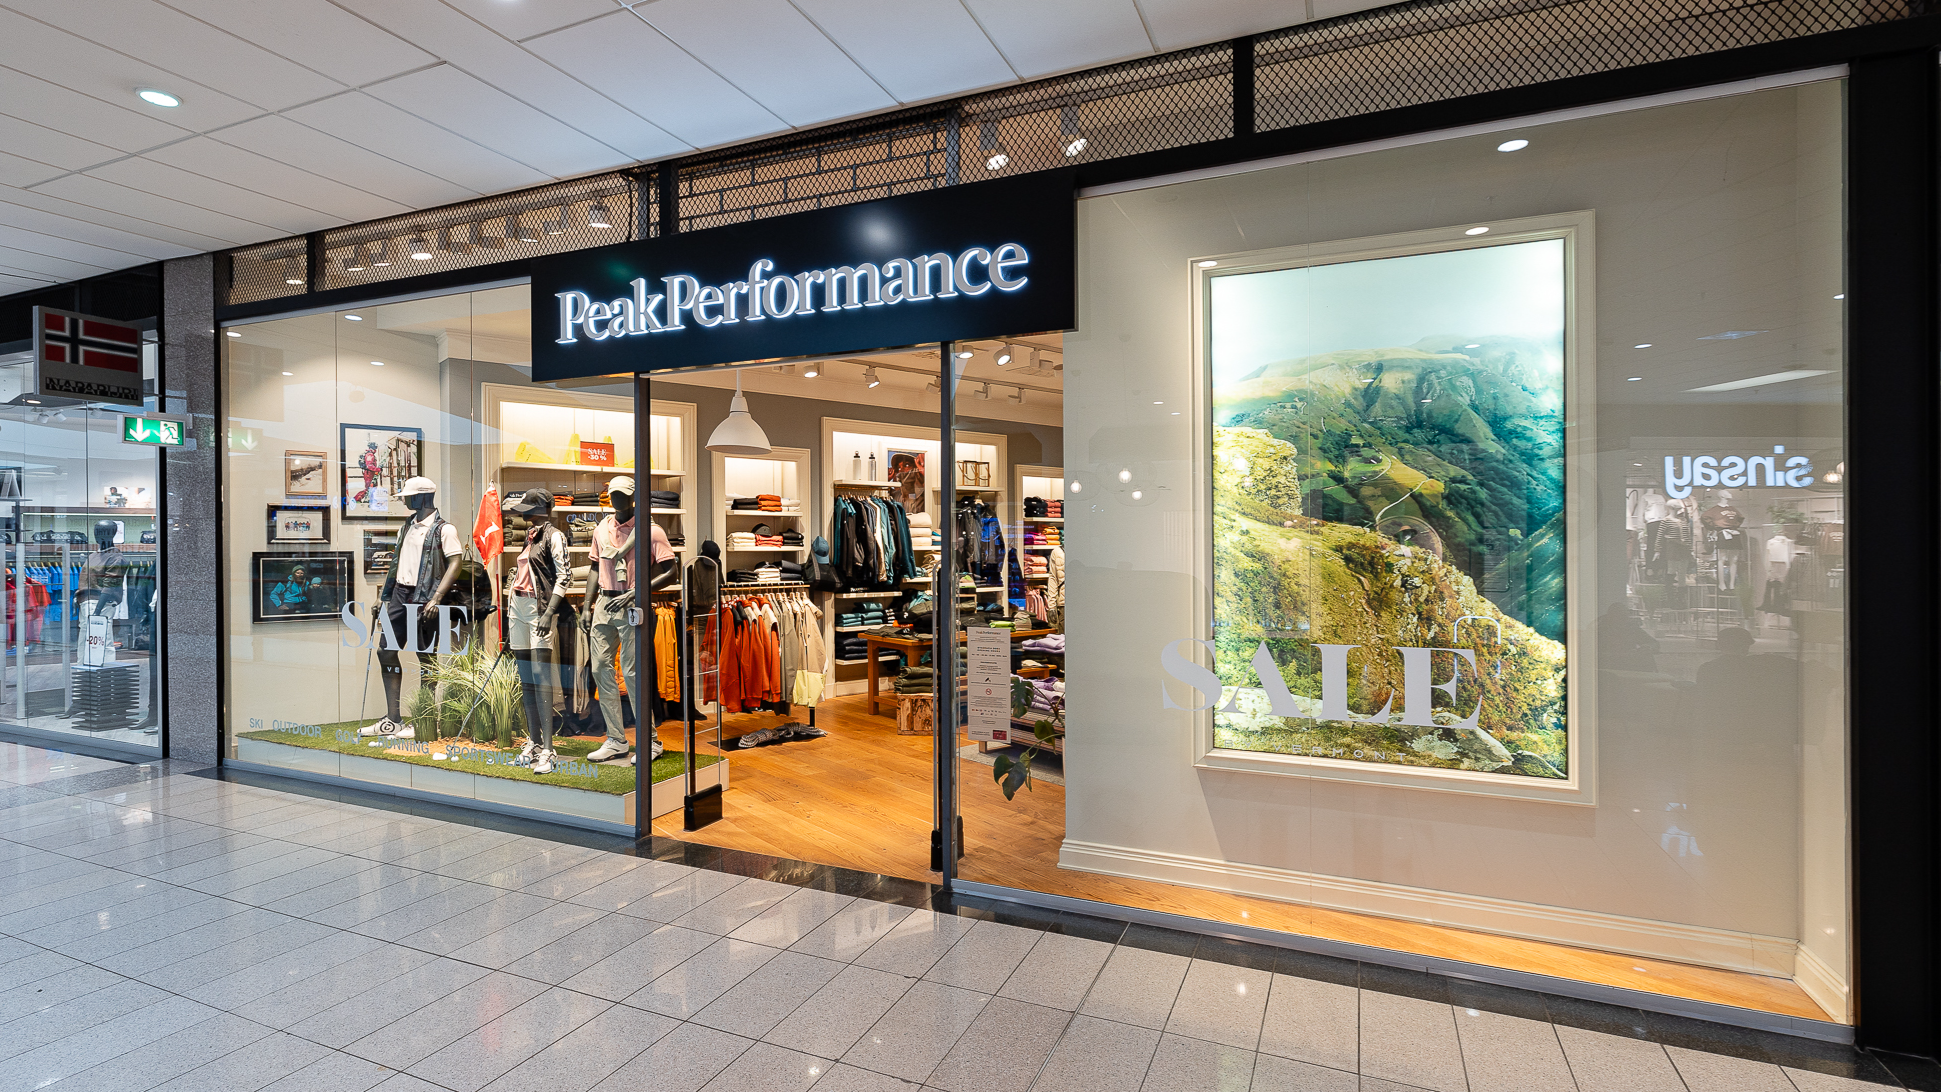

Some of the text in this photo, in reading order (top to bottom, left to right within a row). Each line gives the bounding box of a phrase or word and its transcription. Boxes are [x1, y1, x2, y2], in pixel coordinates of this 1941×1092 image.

[46, 377, 138, 400] NAPAPIJRI
[587, 448, 607, 456] SALE
[341, 600, 470, 656] SALE
[1160, 638, 1483, 730] SALE
[249, 717, 599, 779] SKI OUTDOOR GOLF RUNNING SPORTSWEAR URBAN
[1273, 743, 1407, 762] VERMONT
